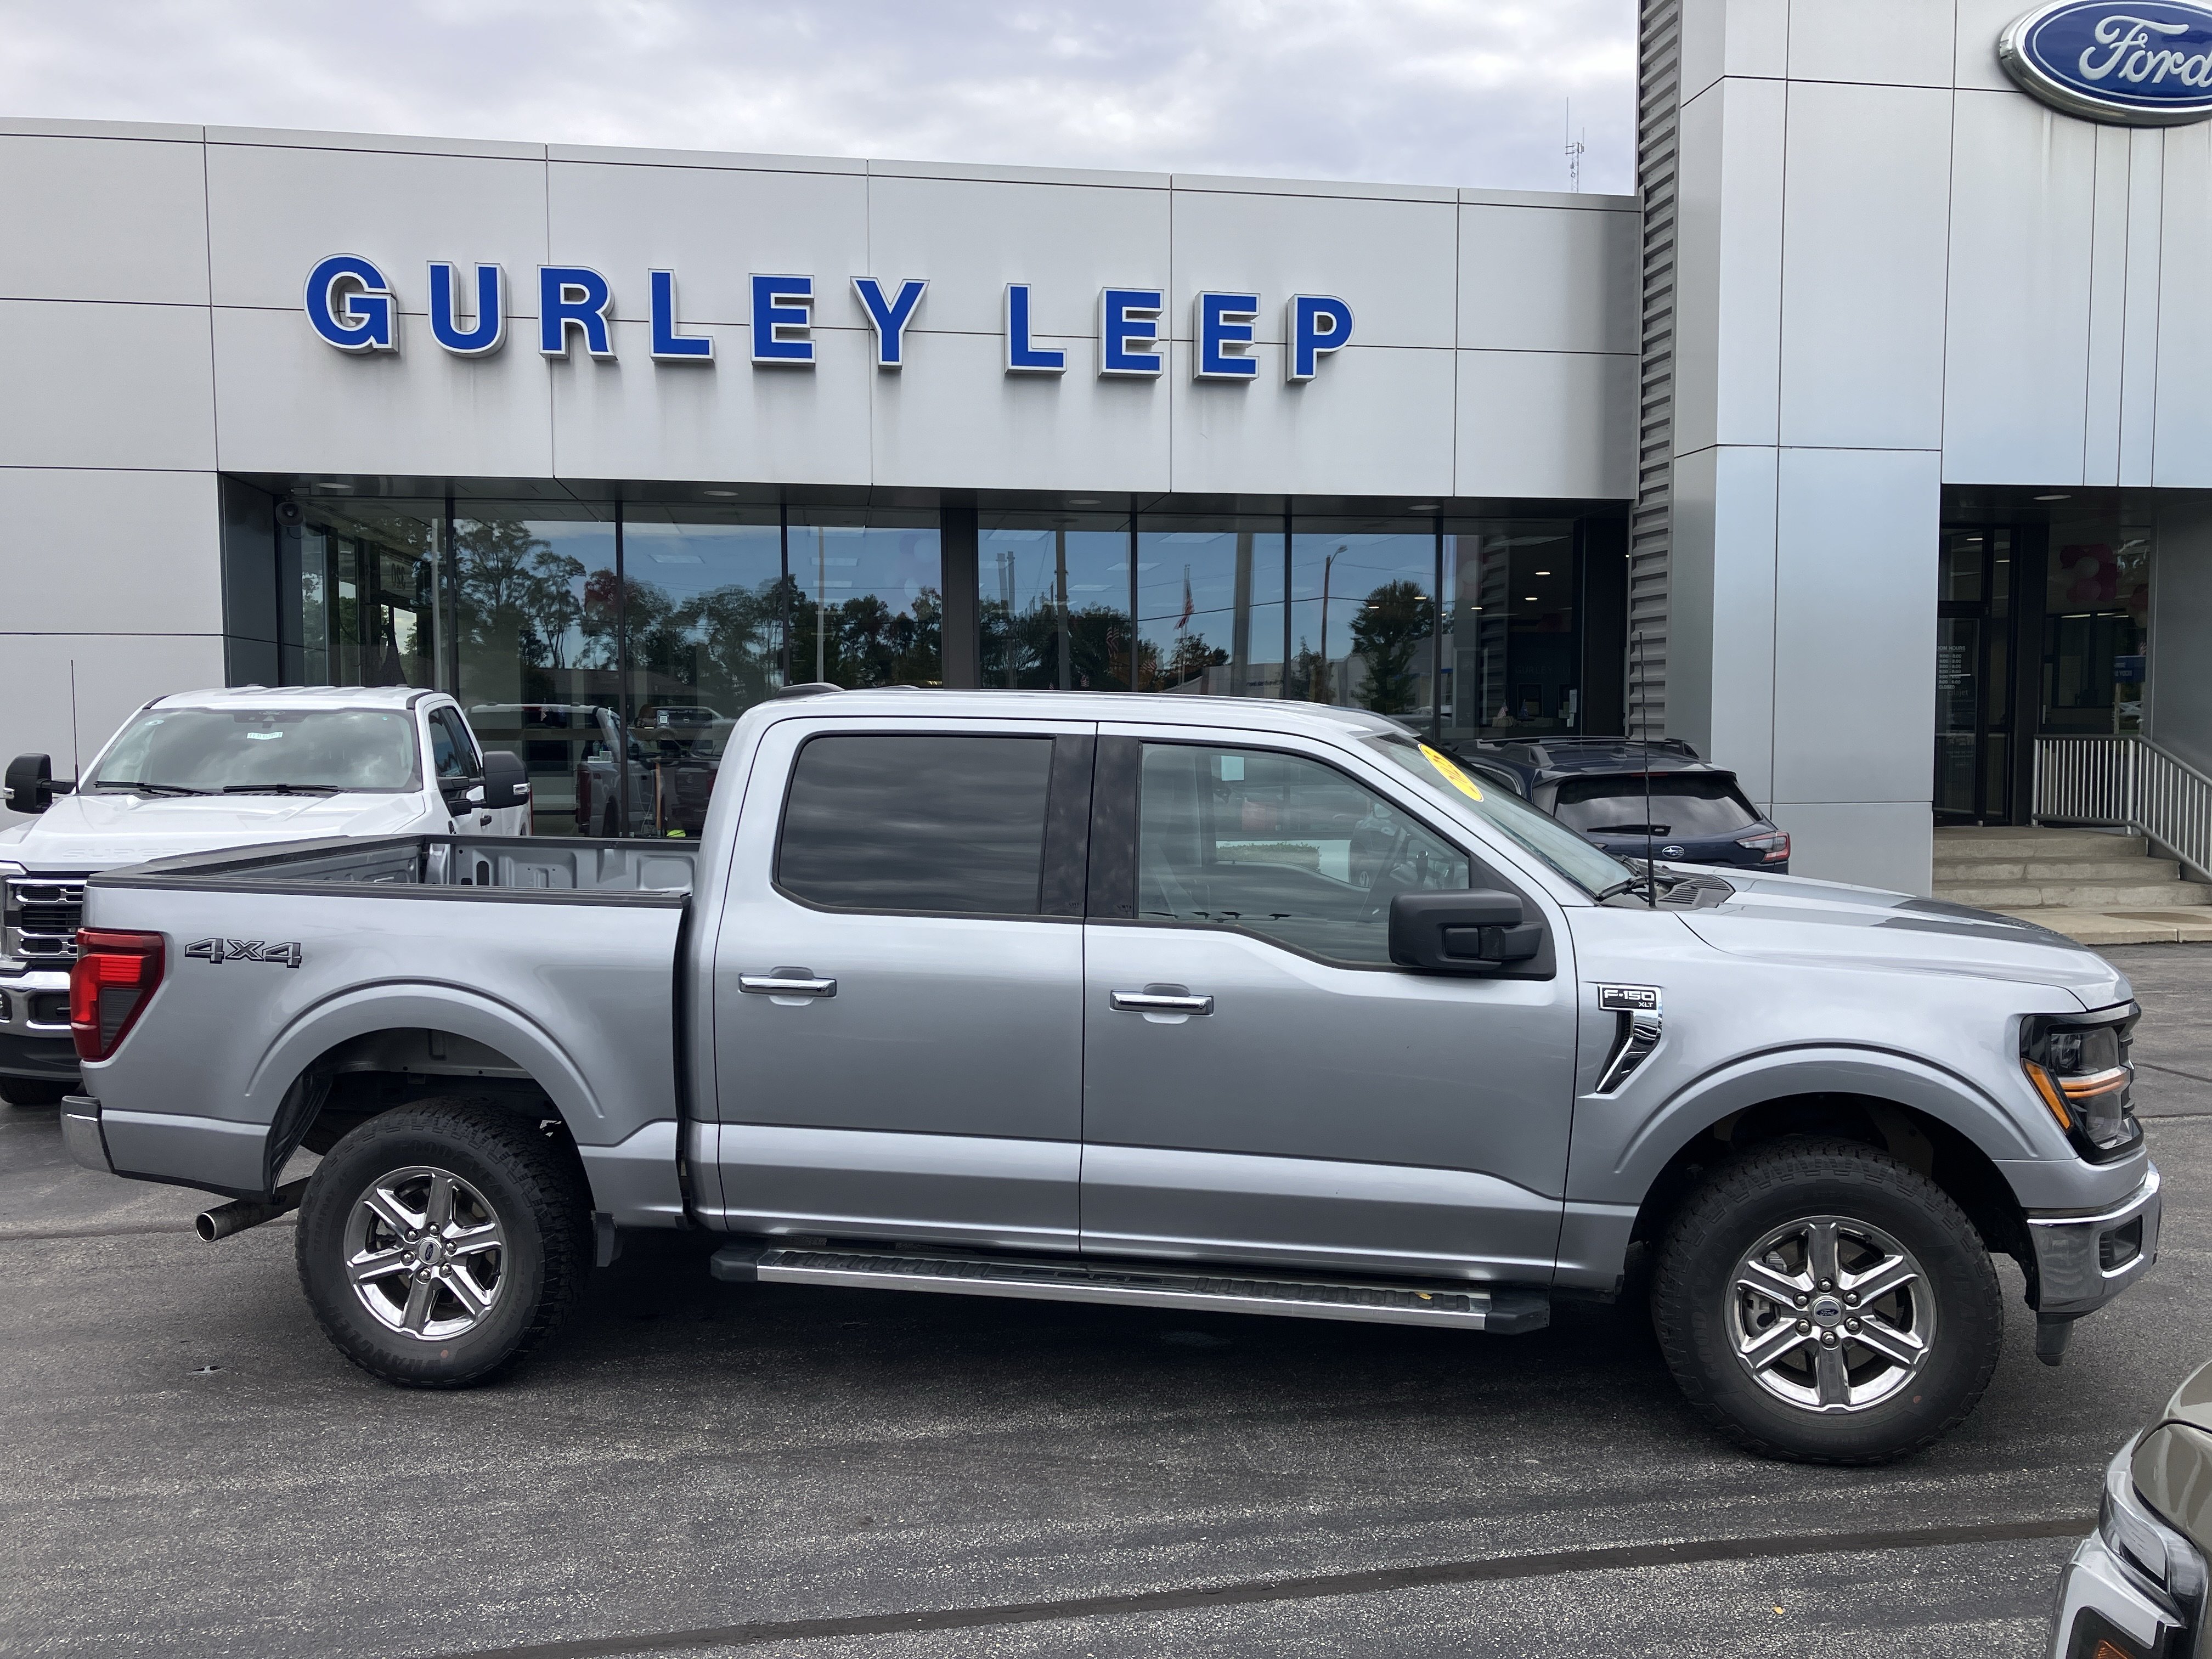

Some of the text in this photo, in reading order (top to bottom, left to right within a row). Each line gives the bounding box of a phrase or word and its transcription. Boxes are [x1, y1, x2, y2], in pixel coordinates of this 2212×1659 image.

[303, 253, 1355, 383] GURLEY LEEP
[1604, 989, 1655, 1001] F-150
